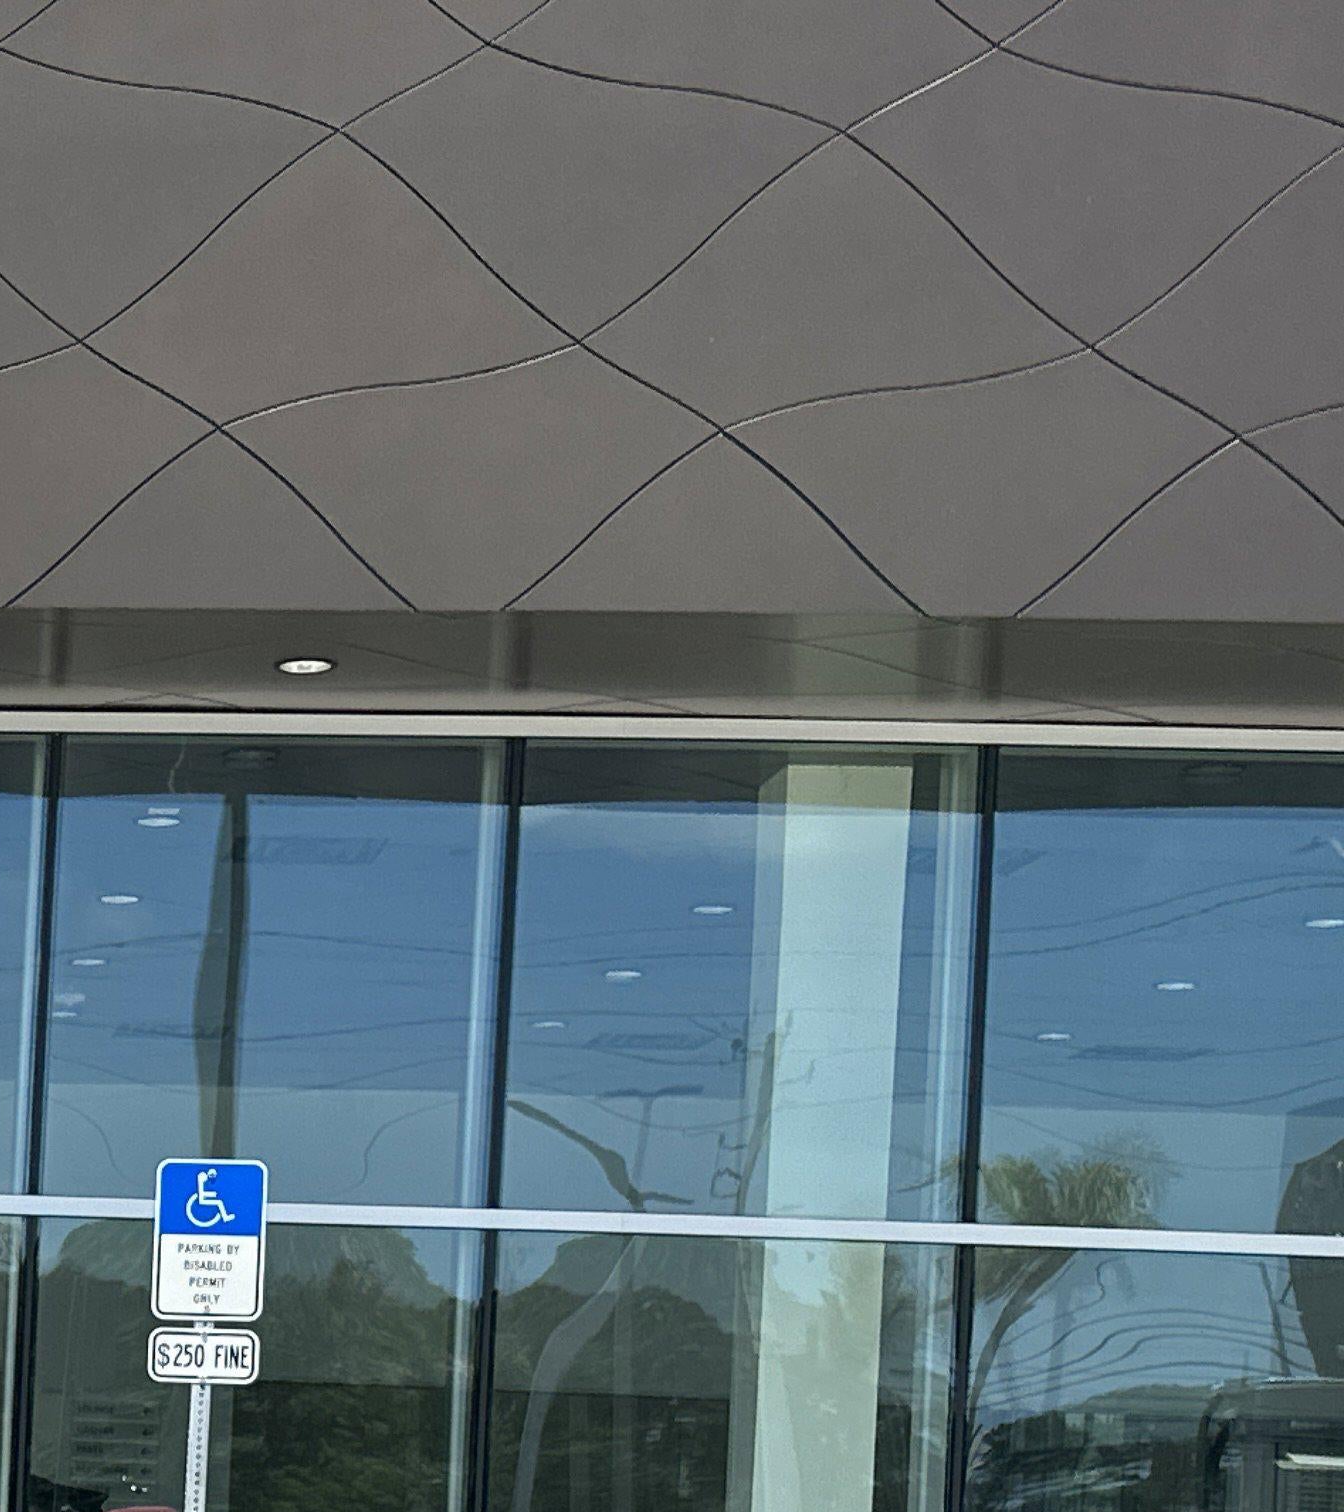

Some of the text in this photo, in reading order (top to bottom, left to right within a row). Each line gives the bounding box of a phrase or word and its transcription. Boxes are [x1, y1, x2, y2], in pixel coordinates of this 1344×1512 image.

[177, 1243, 240, 1255] PARKING BY
[183, 1260, 233, 1271] DISABLED
[188, 1277, 226, 1288] PERMIT
[193, 1294, 220, 1305] ONLY
[157, 1342, 250, 1370] $250 FINE
